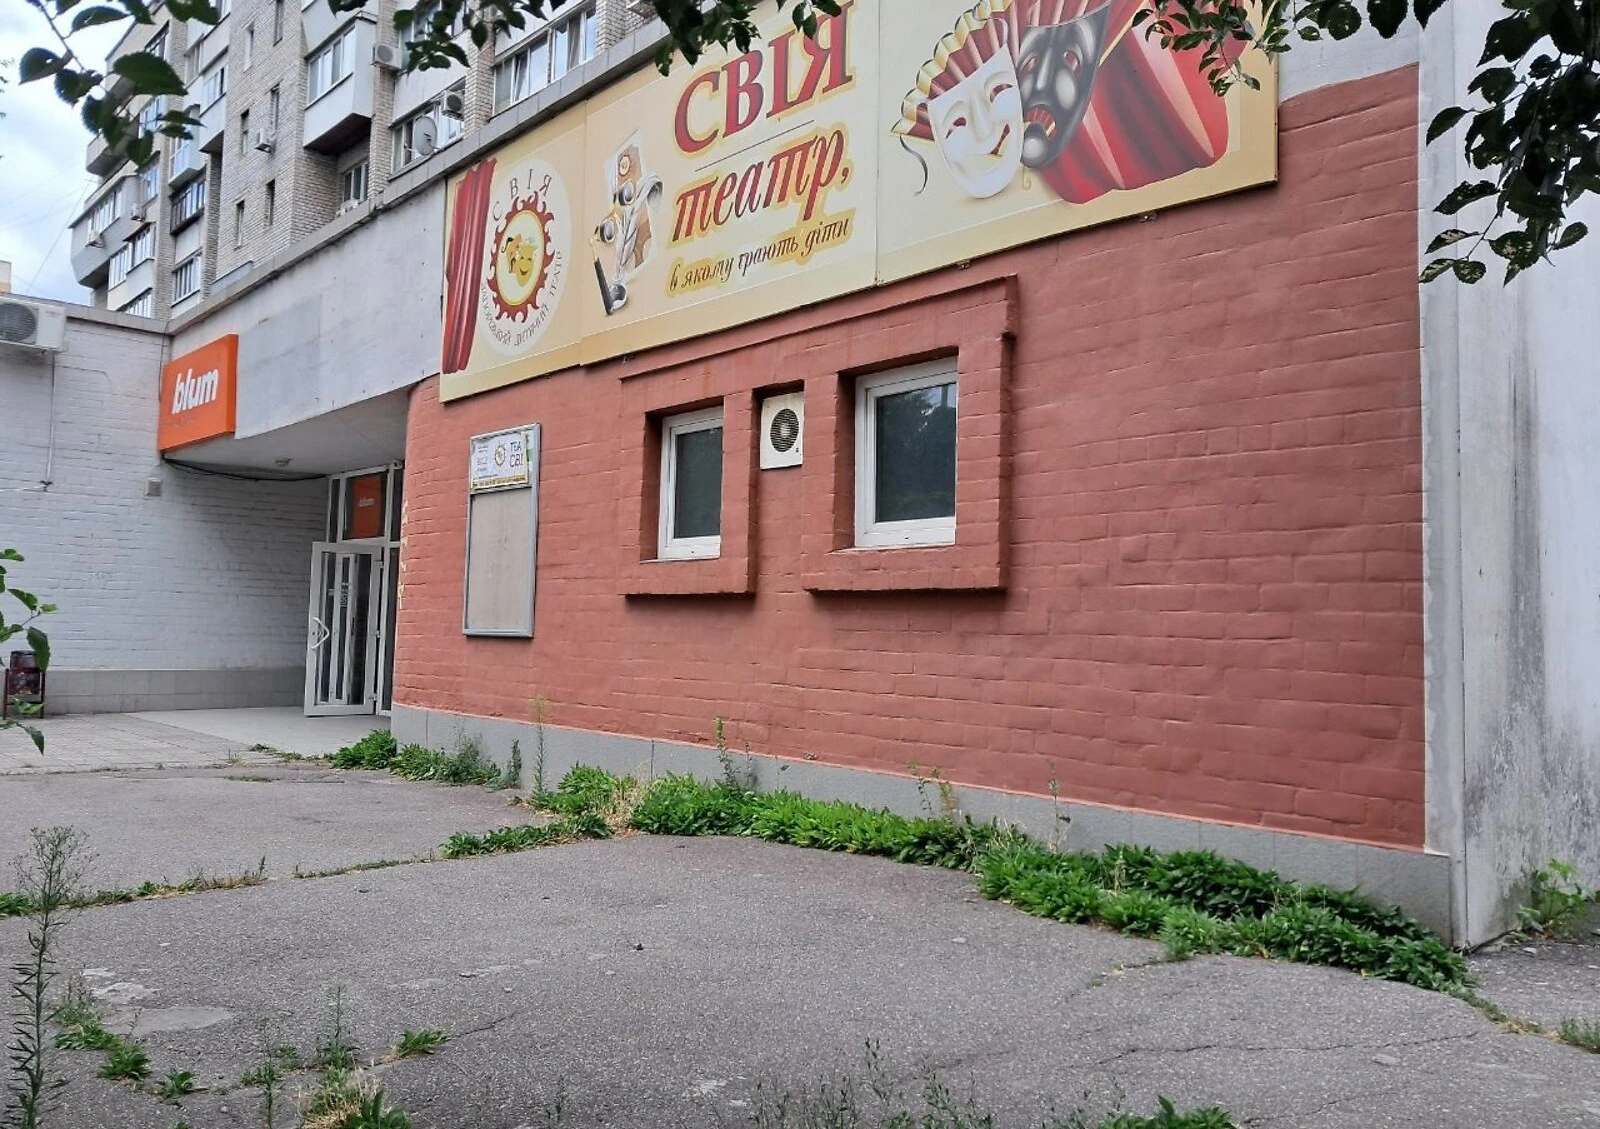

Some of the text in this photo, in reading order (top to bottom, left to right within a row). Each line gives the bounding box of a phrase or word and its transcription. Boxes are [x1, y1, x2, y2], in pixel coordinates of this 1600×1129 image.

[674, 2, 854, 154] СВІЯ
[492, 168, 553, 222] СВІЯ
[672, 129, 850, 243] театр,
[681, 255, 735, 289] якому
[738, 235, 800, 277] грають
[801, 218, 850, 258] діти
[171, 368, 219, 415] blum
